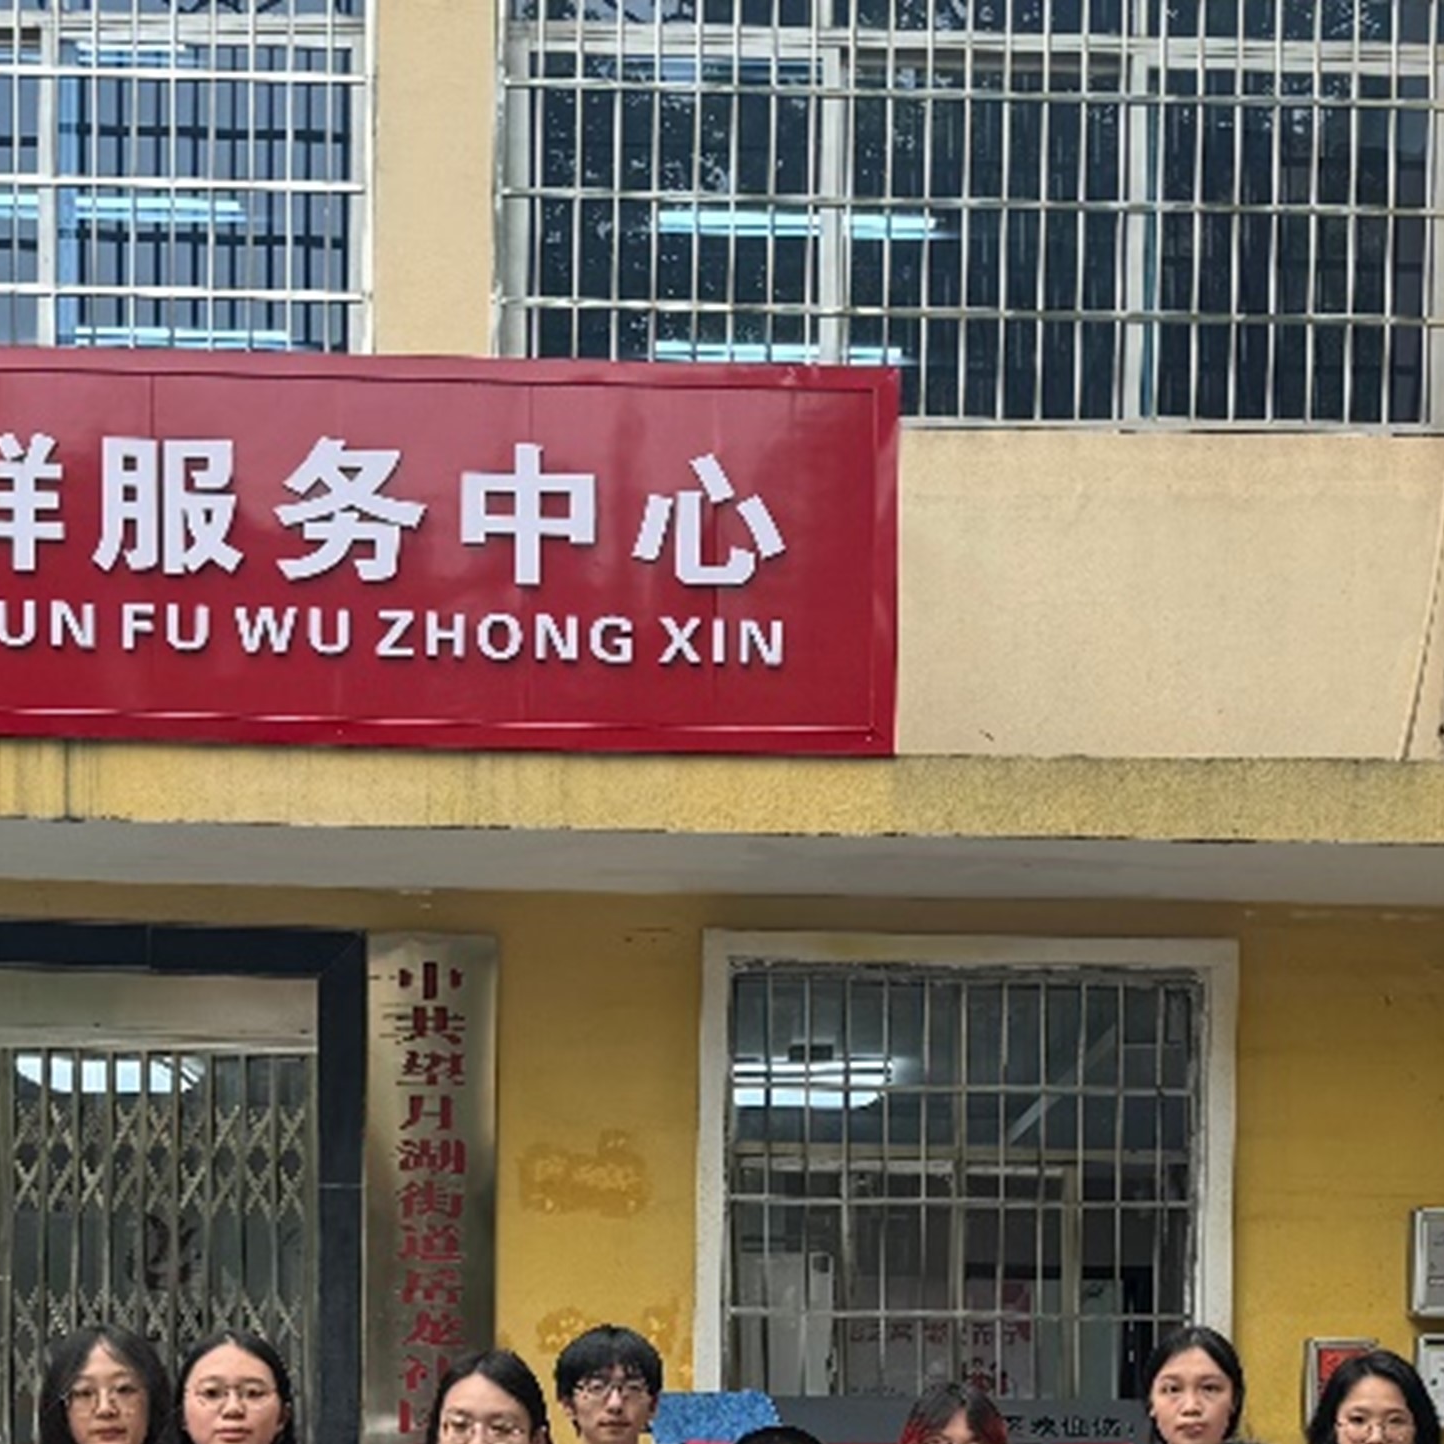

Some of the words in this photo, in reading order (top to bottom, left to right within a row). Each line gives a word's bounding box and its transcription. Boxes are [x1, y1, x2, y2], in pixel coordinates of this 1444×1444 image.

[122, 603, 209, 650] FU
[235, 607, 350, 654] WU
[376, 610, 632, 662] ZHONG
[659, 617, 783, 664] XIN
